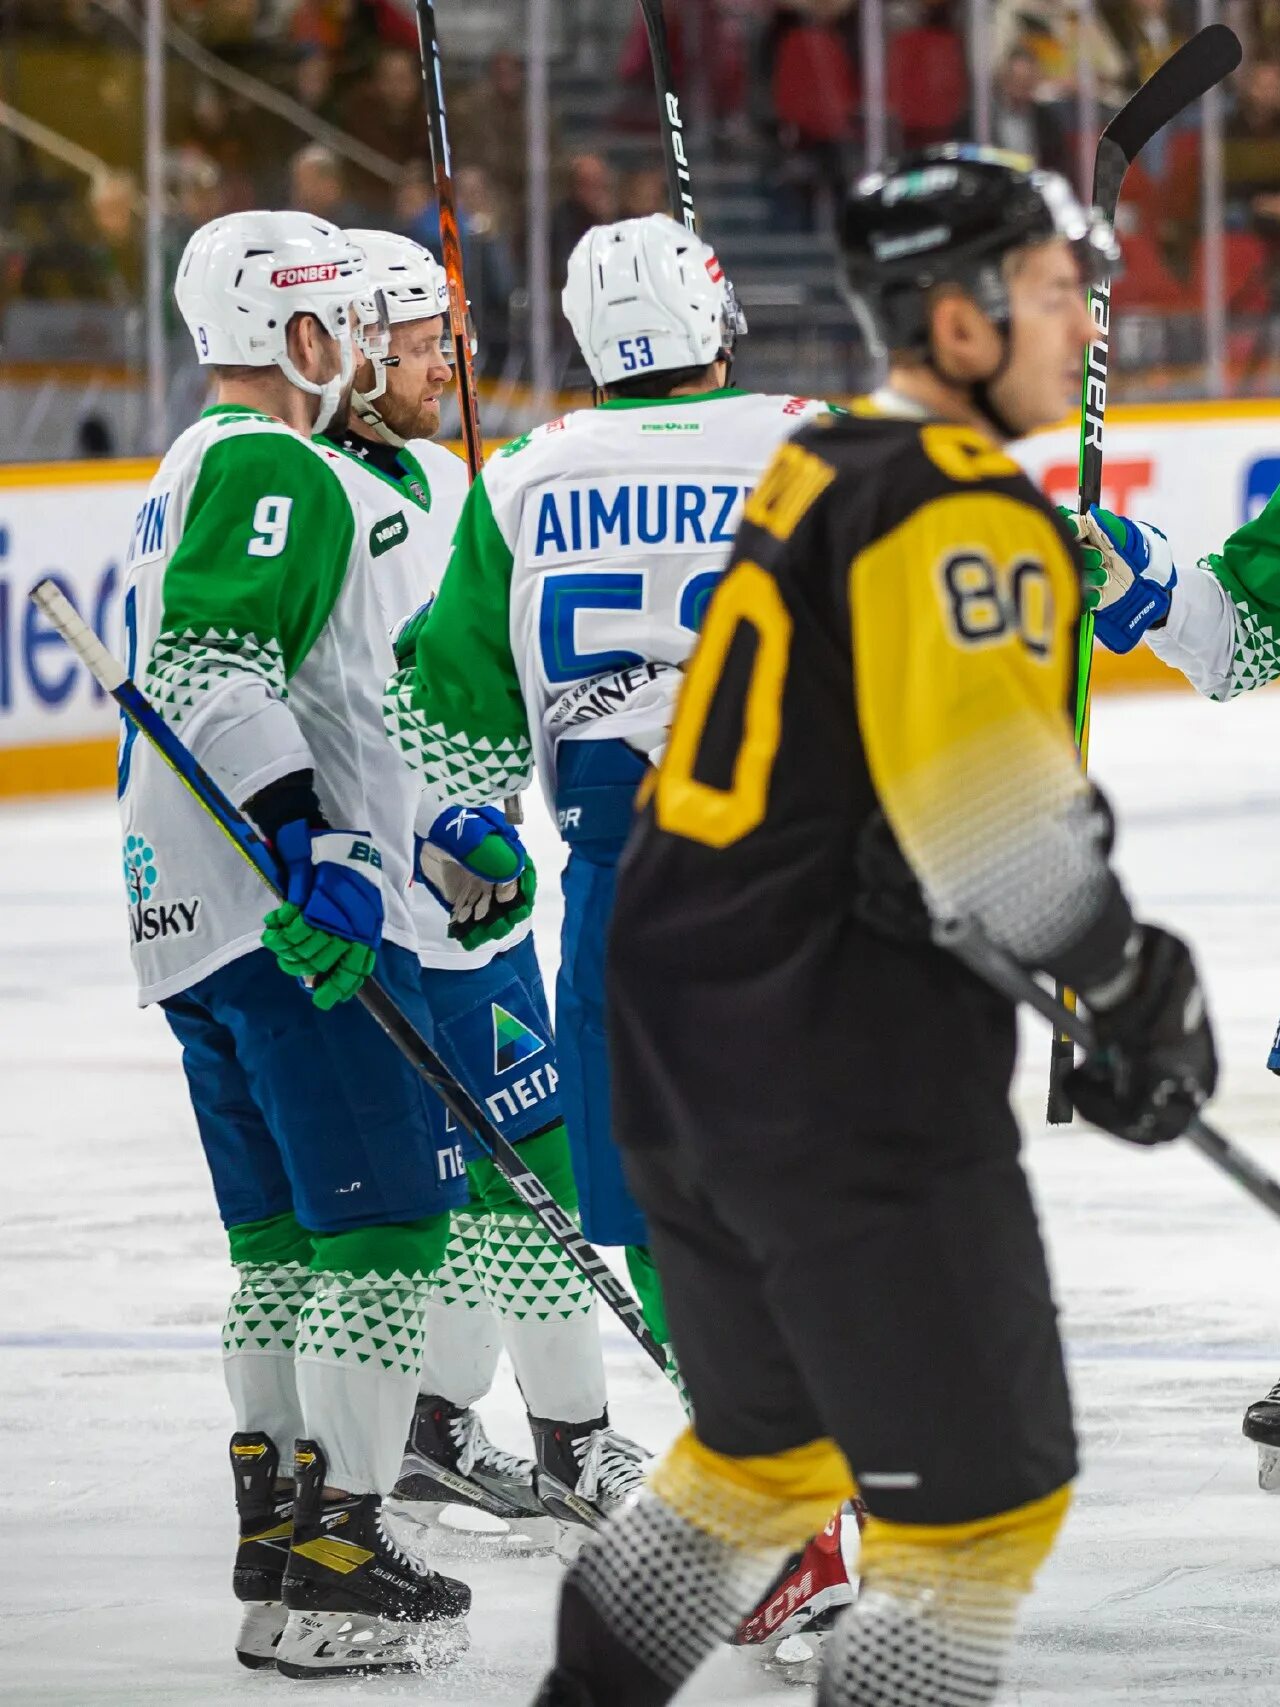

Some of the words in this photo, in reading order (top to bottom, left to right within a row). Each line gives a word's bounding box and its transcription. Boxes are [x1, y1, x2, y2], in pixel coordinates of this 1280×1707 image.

[276, 264, 338, 287] FONBET
[618, 335, 655, 372] 53
[247, 495, 294, 558] 9
[535, 484, 754, 557] AIMURZ
[942, 550, 1056, 663] 80
[370, 1566, 420, 1595] BAUER
